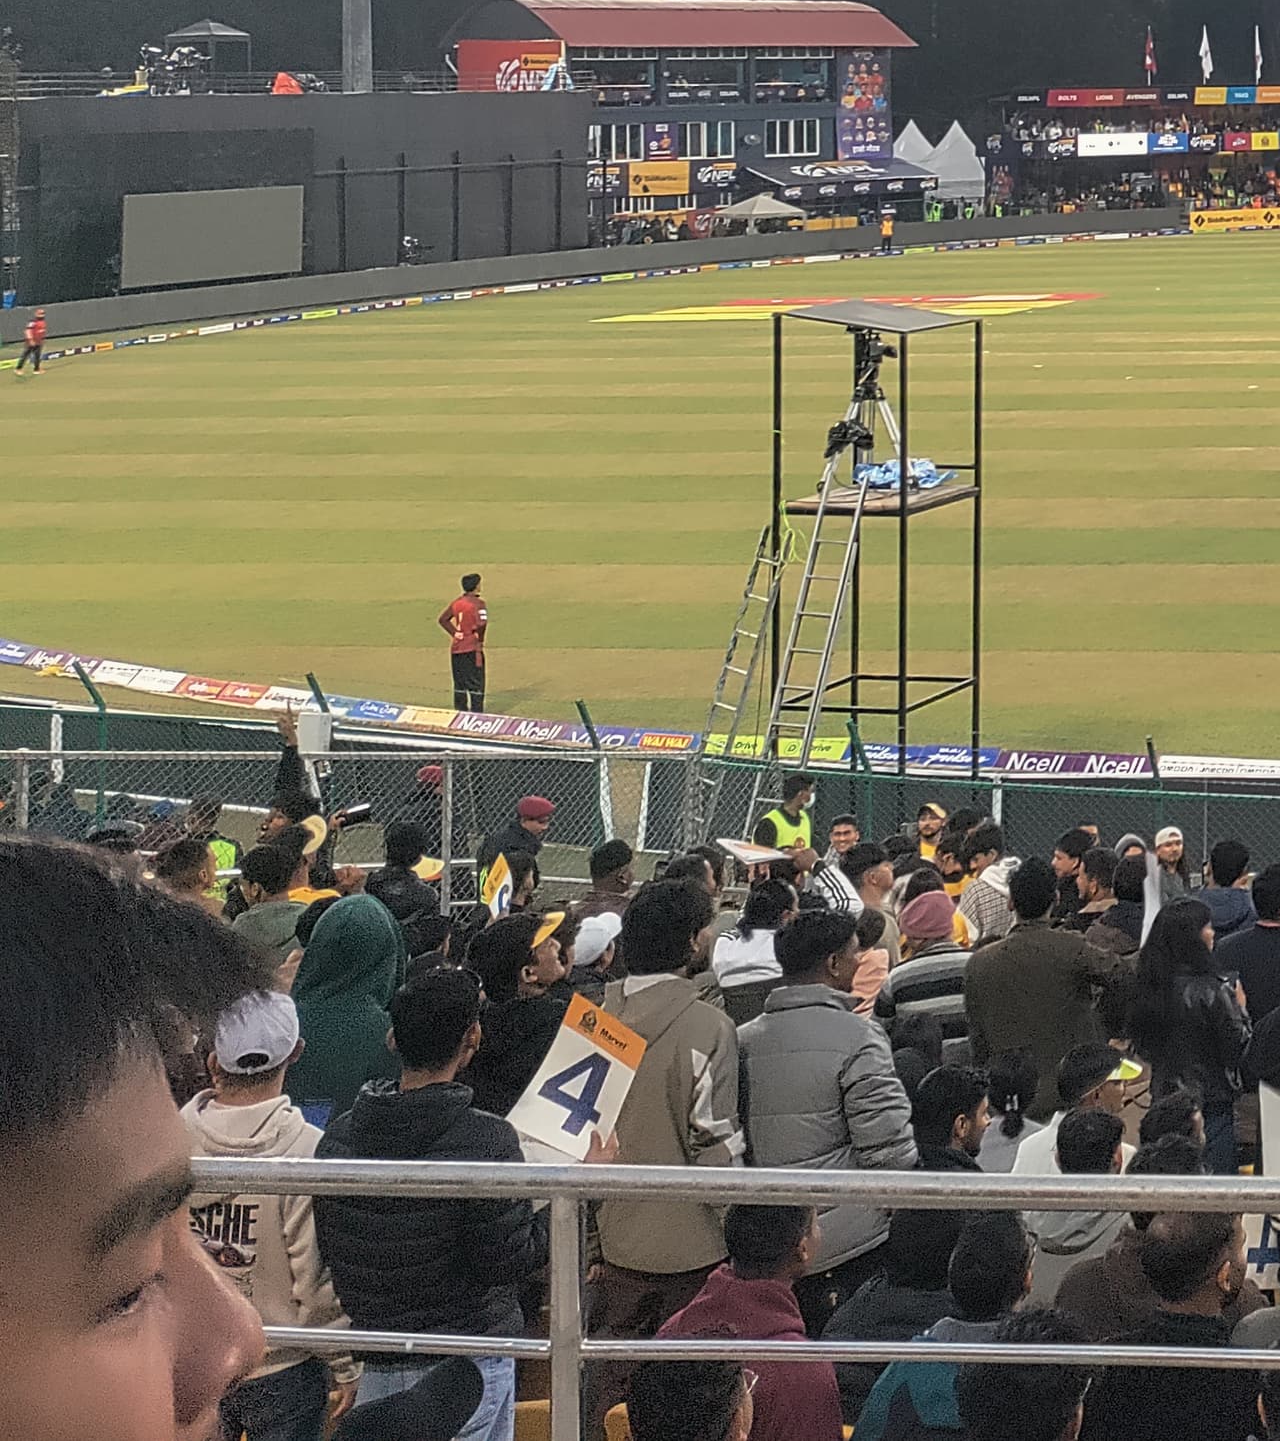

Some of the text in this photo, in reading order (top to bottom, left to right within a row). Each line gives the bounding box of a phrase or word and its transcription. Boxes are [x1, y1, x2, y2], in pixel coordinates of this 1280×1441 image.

[457, 714, 504, 735] Ncell
[515, 719, 562, 741] Ncell
[1006, 752, 1065, 772] Ncell
[1086, 754, 1145, 775] Ncell
[599, 1027, 628, 1052] Marvel
[537, 1051, 612, 1136] 4
